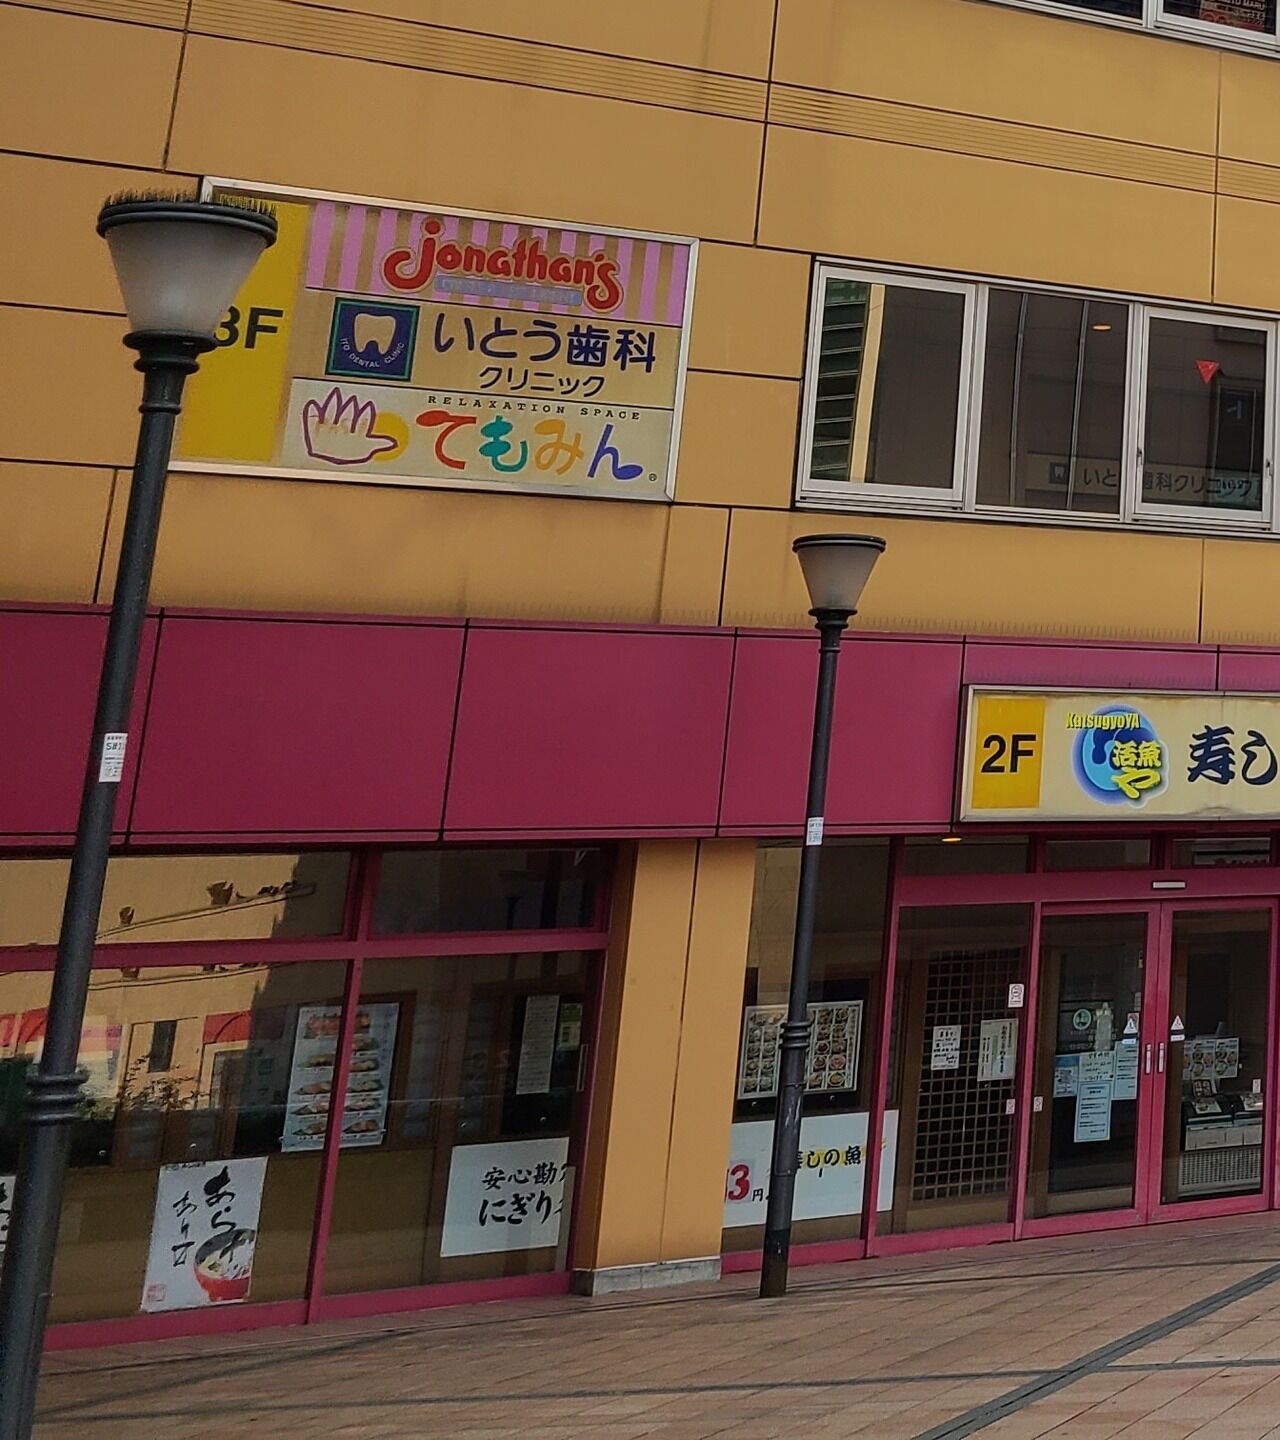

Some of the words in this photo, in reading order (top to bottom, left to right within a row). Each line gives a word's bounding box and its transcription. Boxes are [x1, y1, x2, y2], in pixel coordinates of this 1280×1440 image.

[433, 311, 657, 373] いとう歯科
[479, 365, 605, 398] クリニック
[427, 394, 567, 416] RELAXATION
[593, 405, 642, 422] SPACE
[416, 408, 645, 480] てもみん
[980, 734, 1038, 774] 2F
